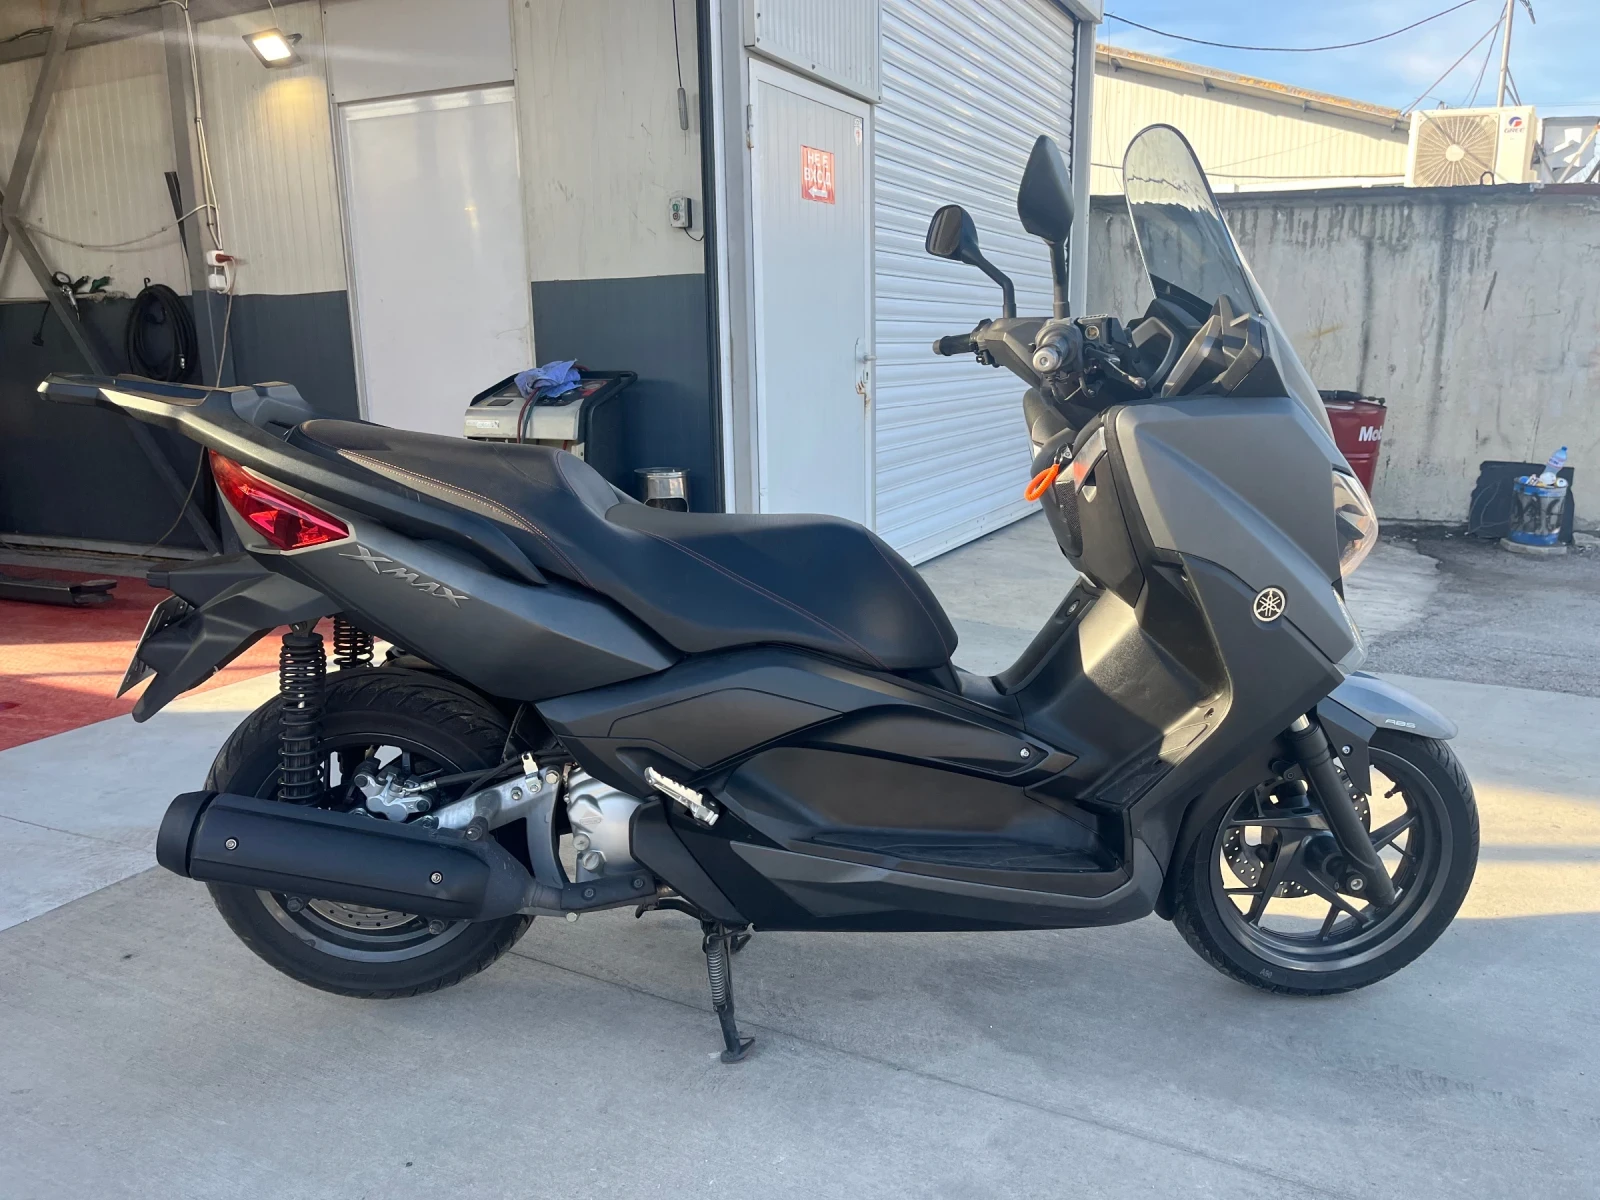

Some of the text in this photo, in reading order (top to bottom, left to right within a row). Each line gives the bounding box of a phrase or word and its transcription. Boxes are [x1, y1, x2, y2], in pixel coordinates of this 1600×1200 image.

[807, 151, 820, 166] НЕ
[804, 167, 832, 188] ВХОД
[1385, 718, 1416, 729] ABS
